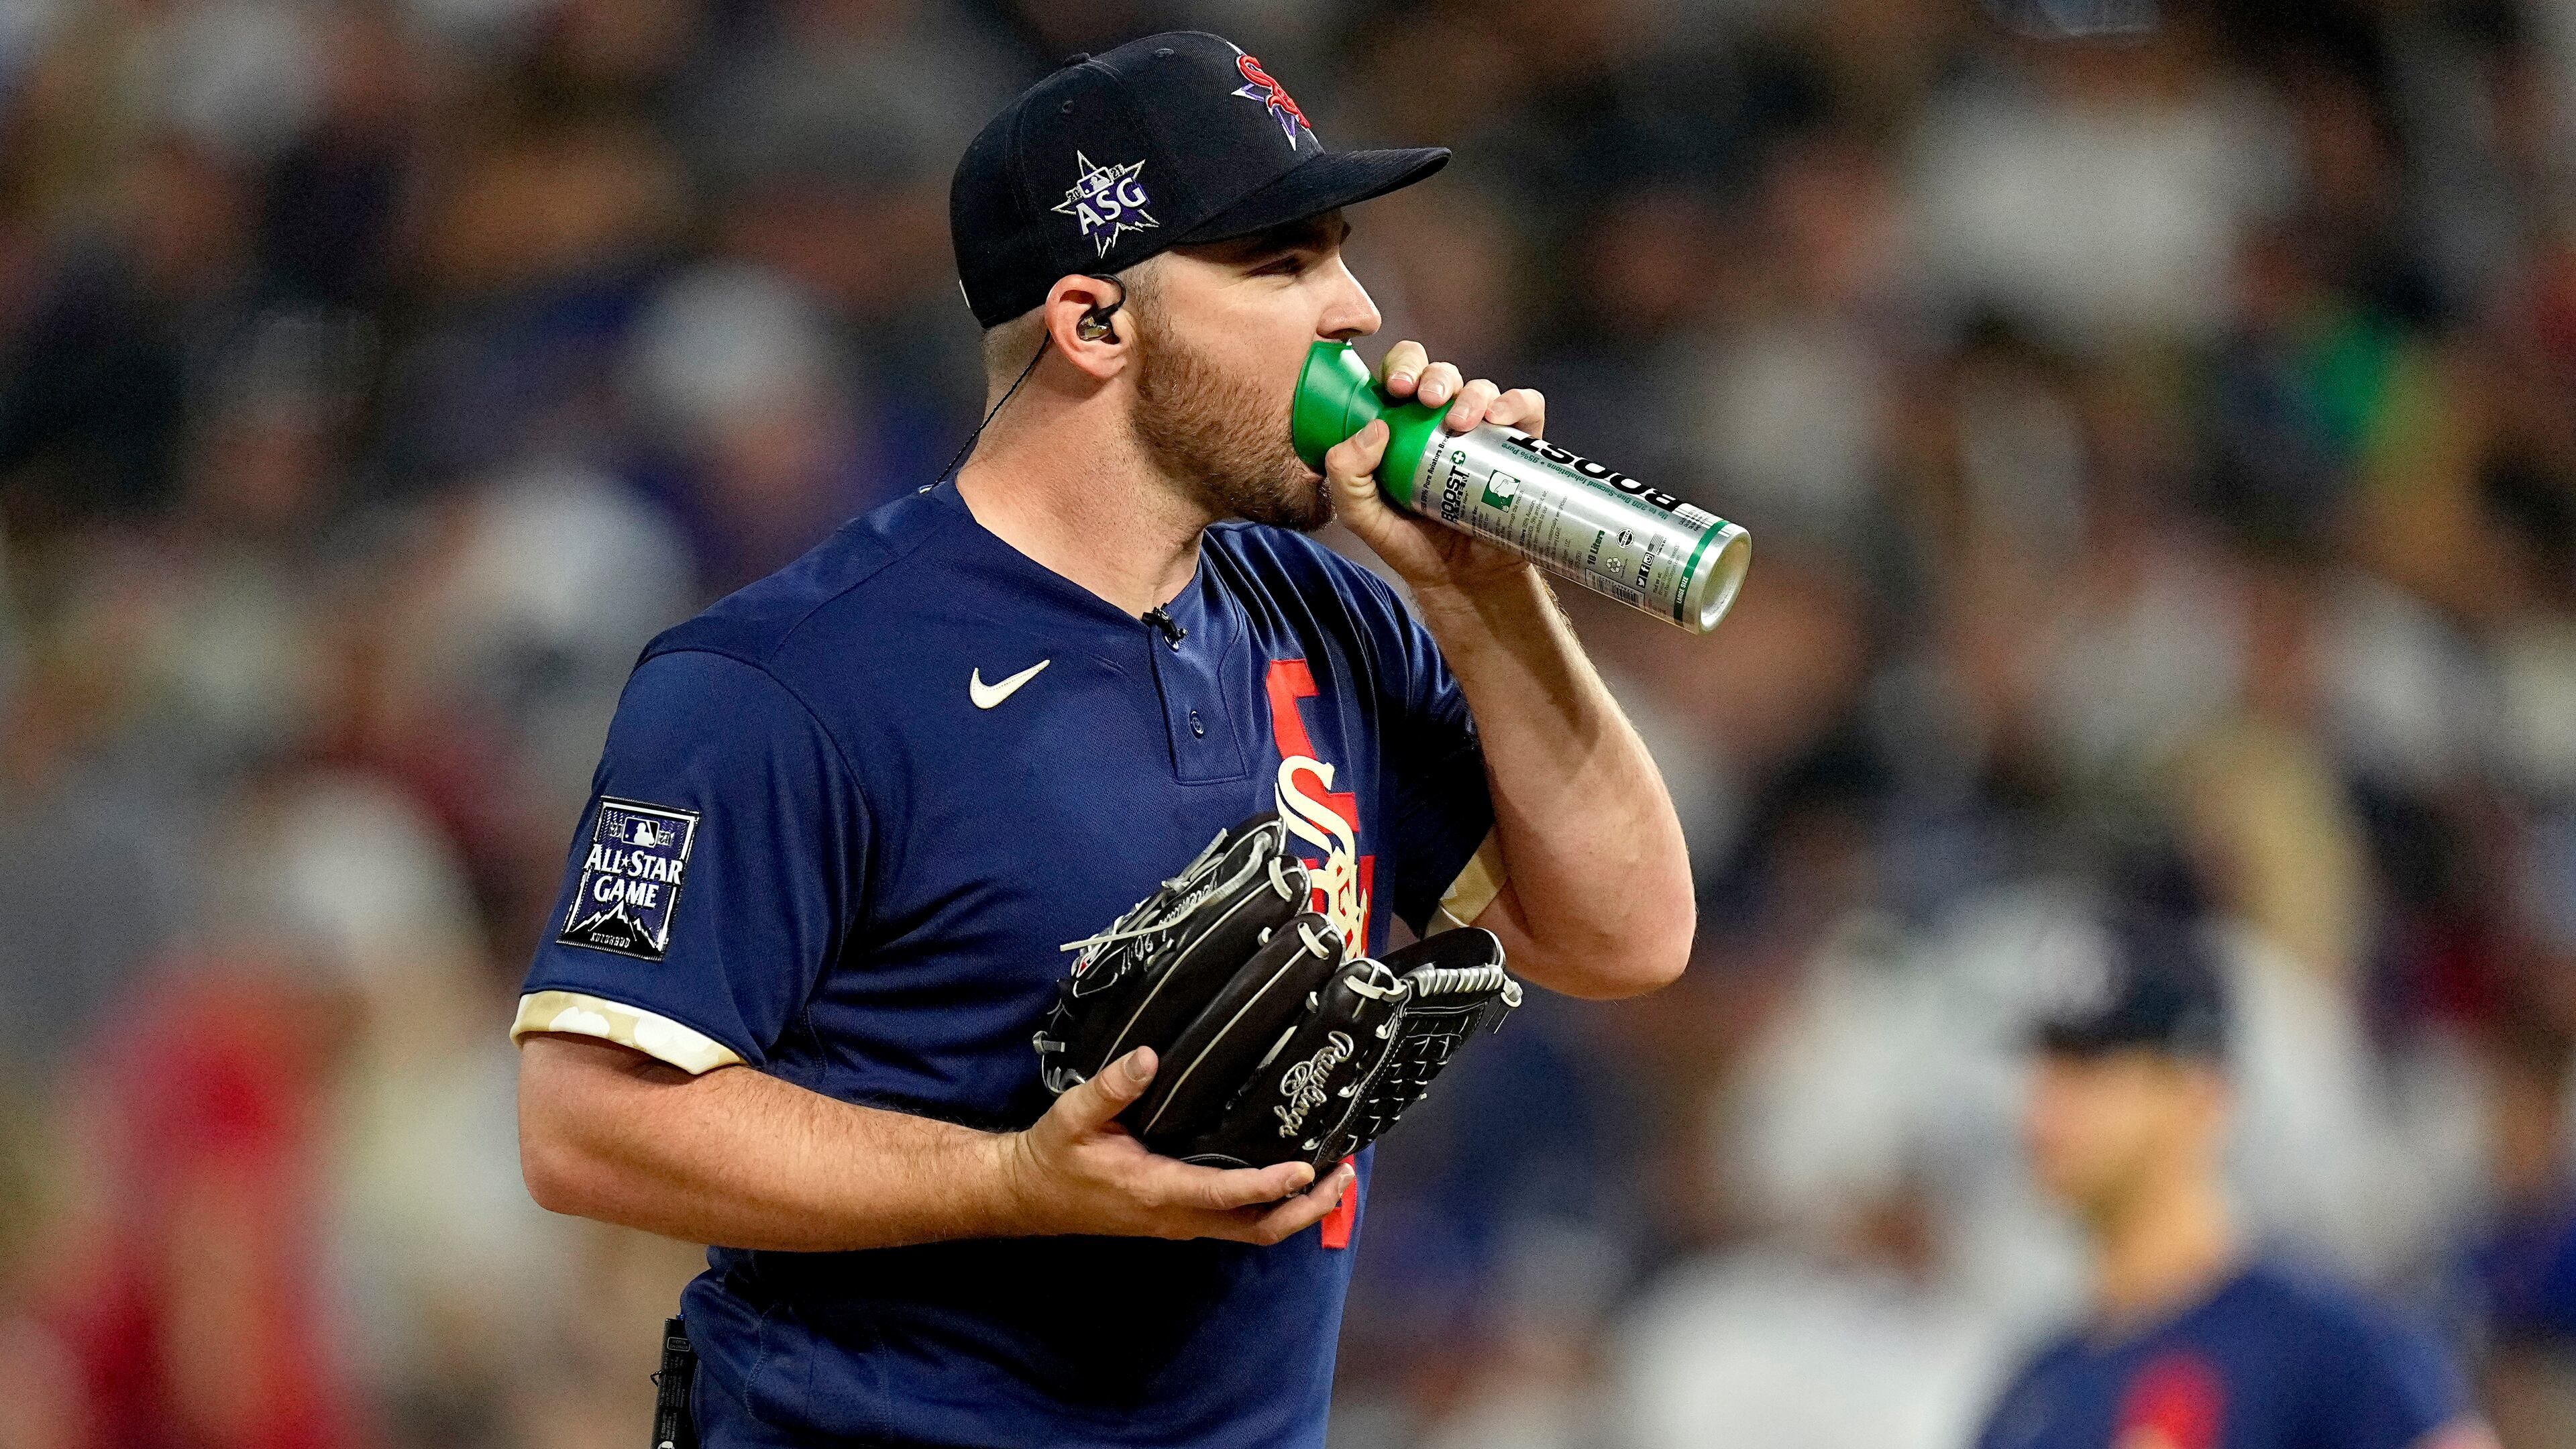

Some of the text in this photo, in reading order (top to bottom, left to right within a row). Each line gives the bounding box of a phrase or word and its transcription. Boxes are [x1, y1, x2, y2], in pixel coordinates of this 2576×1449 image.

[1075, 177, 1146, 235] ASG
[1501, 443, 1519, 456] Pure
[1520, 451, 1541, 466] 95%
[1423, 473, 1432, 489] Pure
[1428, 447, 1442, 475] Aviators
[1507, 436, 1680, 513] BOOST
[1547, 462, 1587, 486] Inhalations
[1441, 465, 1464, 523] BOOST
[1515, 490, 1524, 504] mouh.
[1588, 480, 1631, 505] One-Second
[1631, 499, 1648, 511] 200
[1658, 511, 1669, 520] Up
[1587, 530, 1605, 565] 10 Liters
[1676, 588, 1685, 604] LARGE
[584, 844, 683, 885] ALL STAR
[594, 875, 659, 908] GAME
[1273, 1030, 1354, 1138] Rawlings
